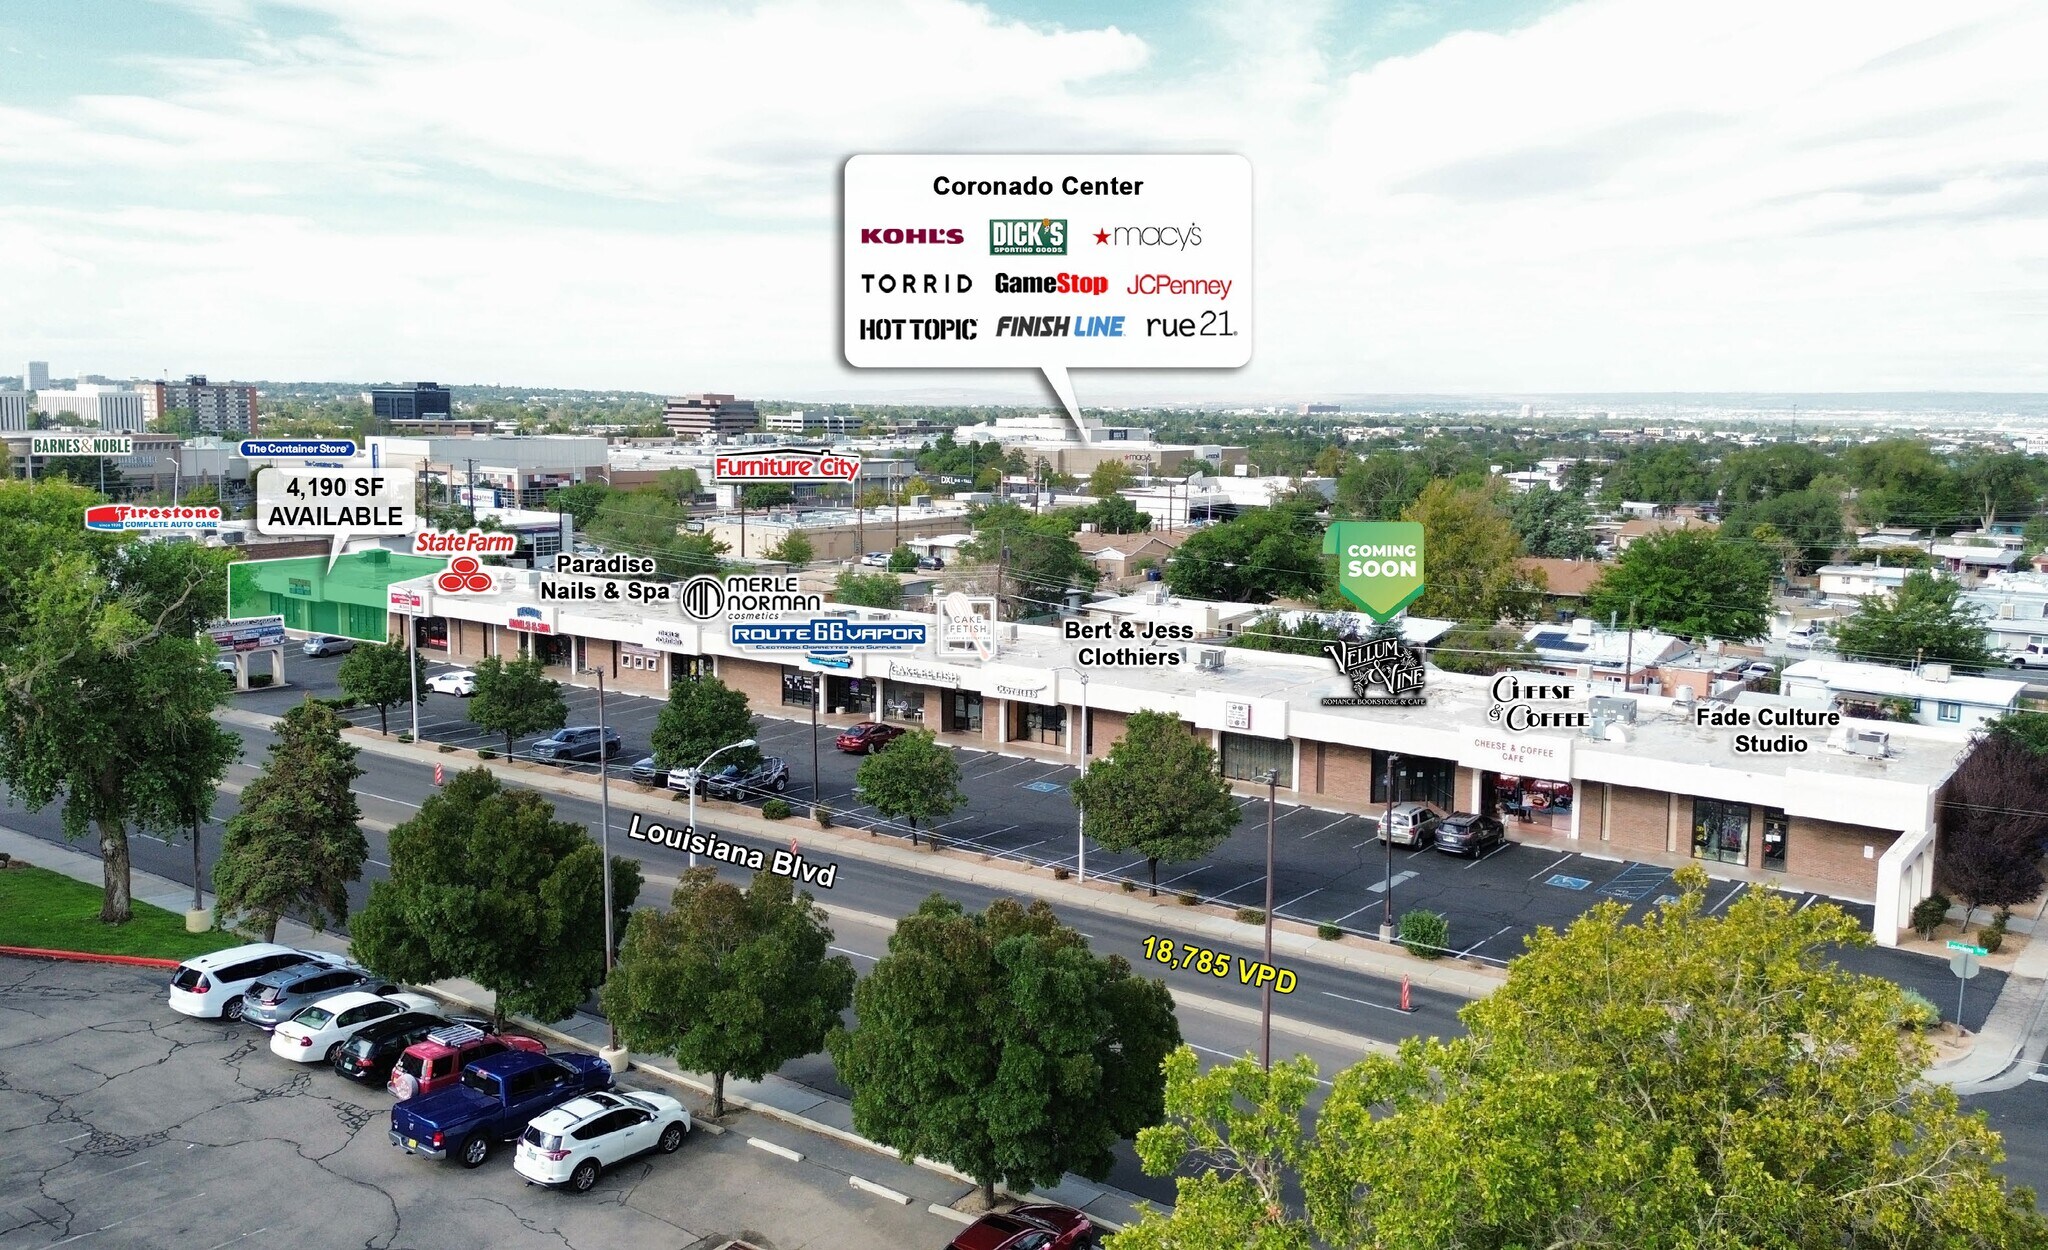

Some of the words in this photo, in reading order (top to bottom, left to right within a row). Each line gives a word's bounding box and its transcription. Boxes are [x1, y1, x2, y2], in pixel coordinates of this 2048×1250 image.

[940, 475, 956, 485] DXL
[1474, 738, 1507, 751] CHEESE
[1510, 744, 1517, 752] &
[1520, 745, 1555, 758] COFFEE
[1502, 752, 1525, 764] CAFE
